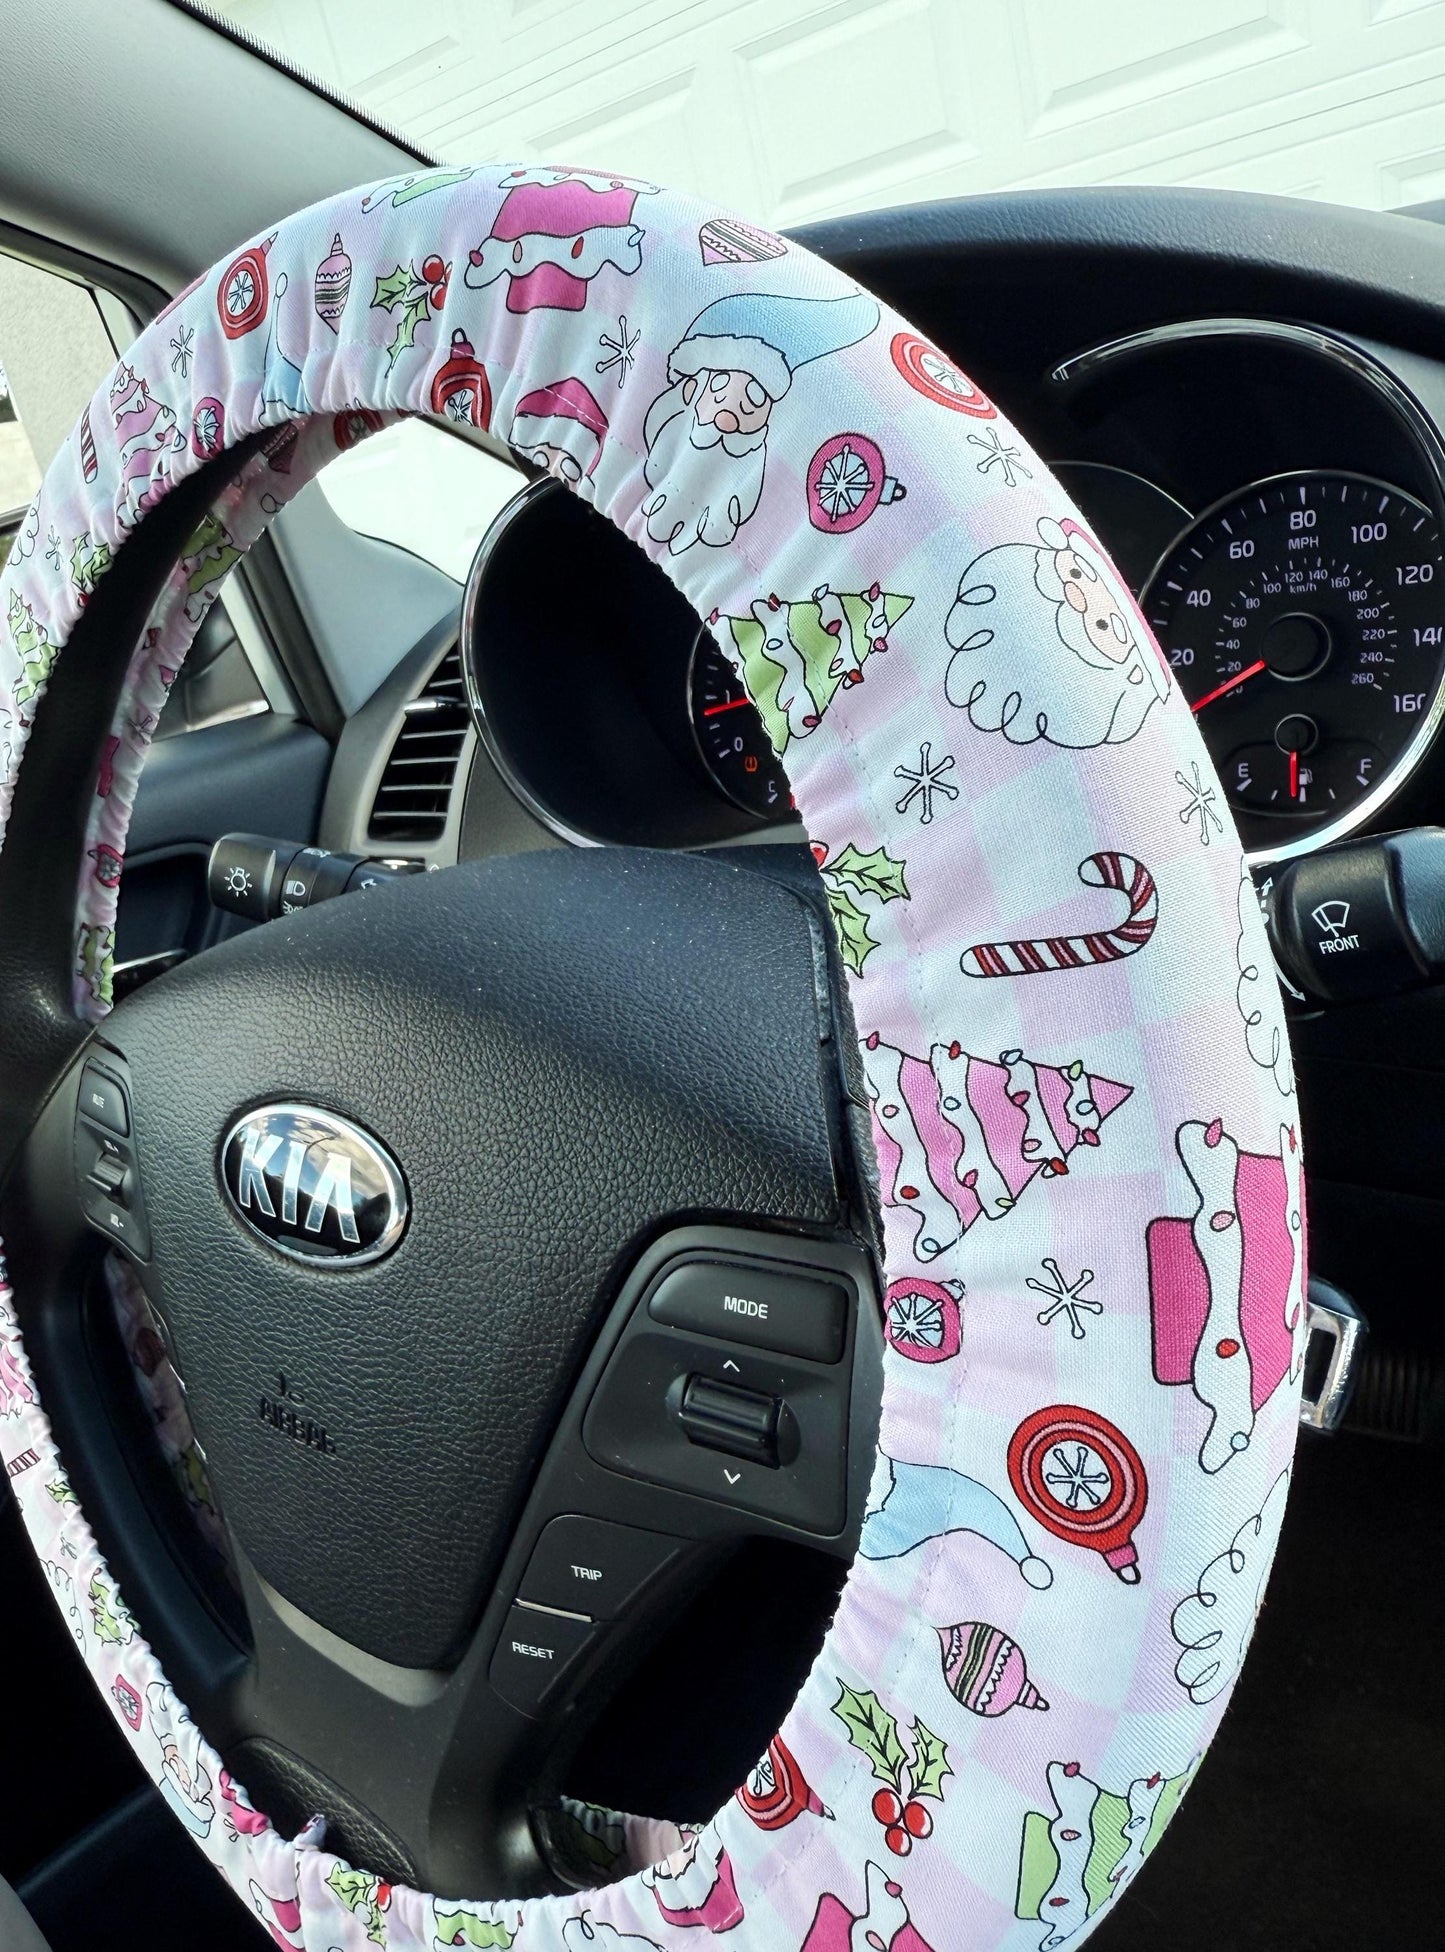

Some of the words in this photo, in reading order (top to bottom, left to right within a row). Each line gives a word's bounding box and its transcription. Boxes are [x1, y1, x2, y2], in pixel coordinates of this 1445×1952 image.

[1290, 510, 1316, 530] 80
[1351, 523, 1387, 543] 100
[1230, 540, 1254, 559] 60
[1289, 536, 1318, 550] MPH
[1285, 572, 1303, 583] 120
[1308, 569, 1328, 580] 140
[1396, 565, 1433, 585] 120
[1263, 583, 1282, 593] 100
[1289, 583, 1317, 593] km/h
[1331, 577, 1350, 588] 160
[1187, 590, 1211, 607] 40
[1348, 590, 1367, 601] 180
[1245, 598, 1260, 609] 80
[1356, 608, 1379, 619] 200
[1231, 617, 1246, 628] 60
[1362, 629, 1385, 640] 220
[1226, 639, 1240, 649] 40
[1170, 649, 1194, 666] 20
[1360, 652, 1383, 663] 240
[1227, 661, 1241, 672] 20
[1351, 674, 1374, 685] 260
[734, 737, 743, 751] 0
[1238, 763, 1248, 777] E
[1361, 759, 1371, 774] F
[1319, 935, 1359, 954] FRONT
[239, 1126, 361, 1243] KIA
[724, 1296, 768, 1319] MODE
[571, 1566, 602, 1580] TRIP
[512, 1642, 554, 1659] RESET
